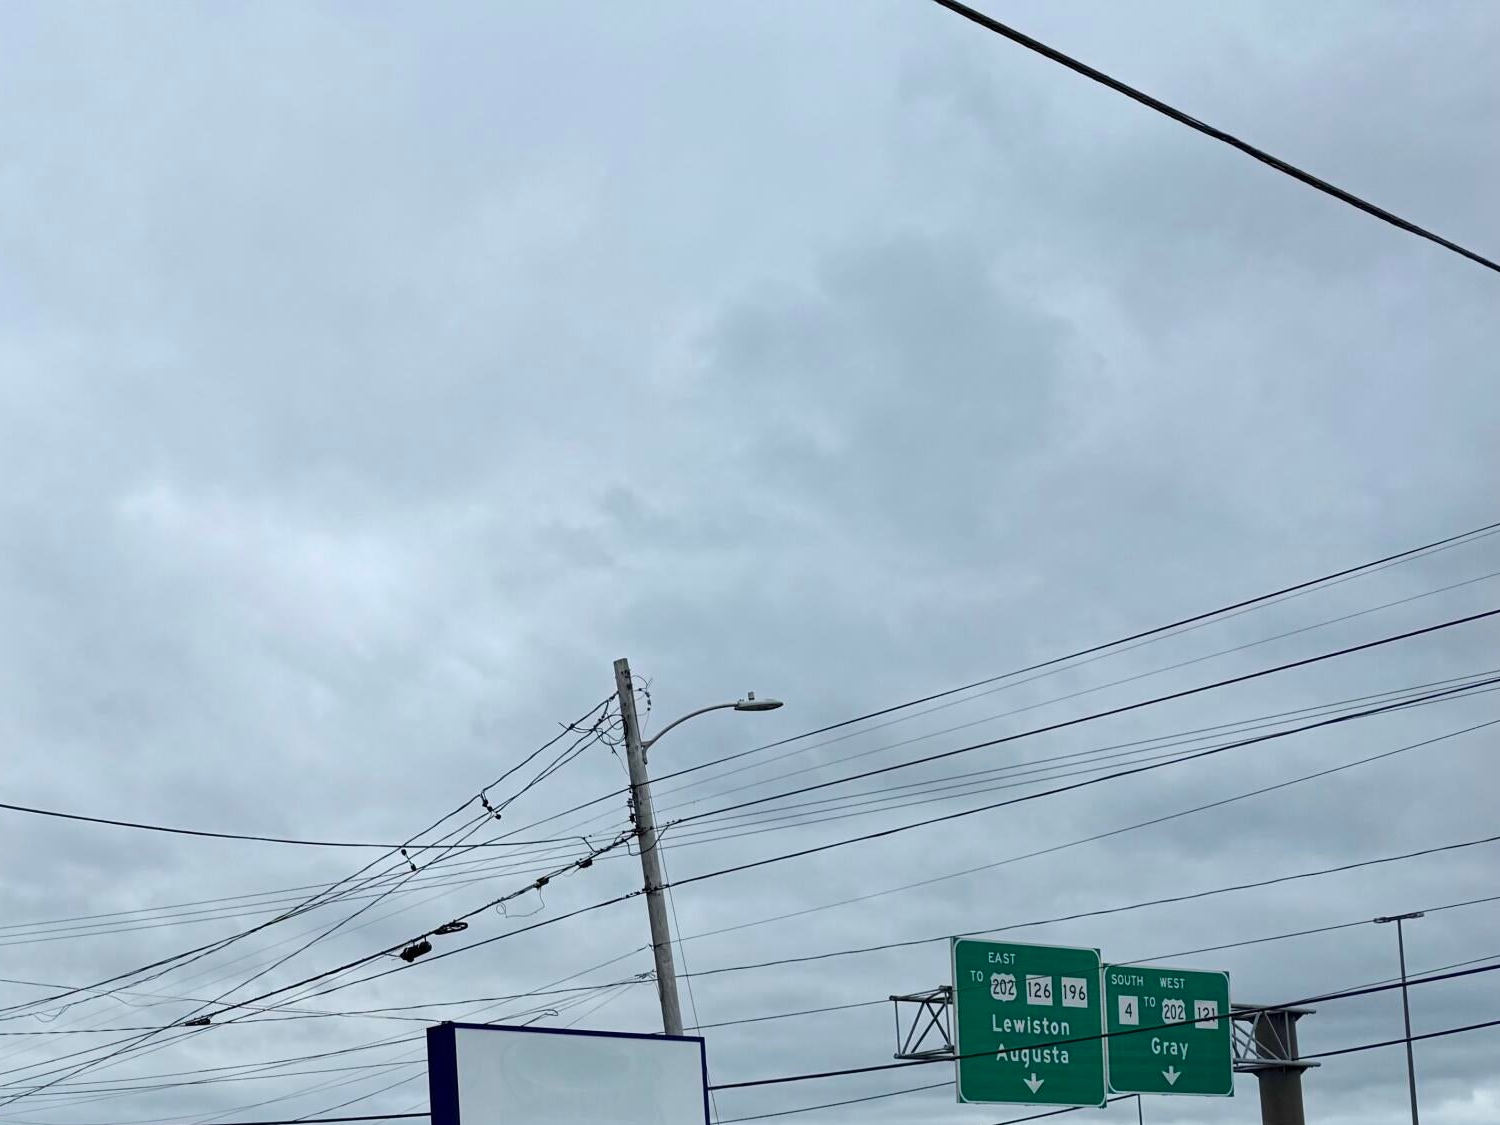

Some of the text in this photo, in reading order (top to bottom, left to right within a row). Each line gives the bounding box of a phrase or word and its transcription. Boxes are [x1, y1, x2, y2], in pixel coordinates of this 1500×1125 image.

[988, 952, 1016, 964] EAST
[970, 970, 1086, 1001] TO 202 126 196
[1111, 974, 1185, 989] SOUTH WEST
[1125, 996, 1216, 1022] 4 TO 202 121
[992, 1014, 1070, 1036] Lewiston
[996, 1043, 1069, 1068] Augusta
[1151, 1037, 1189, 1060] Gray
